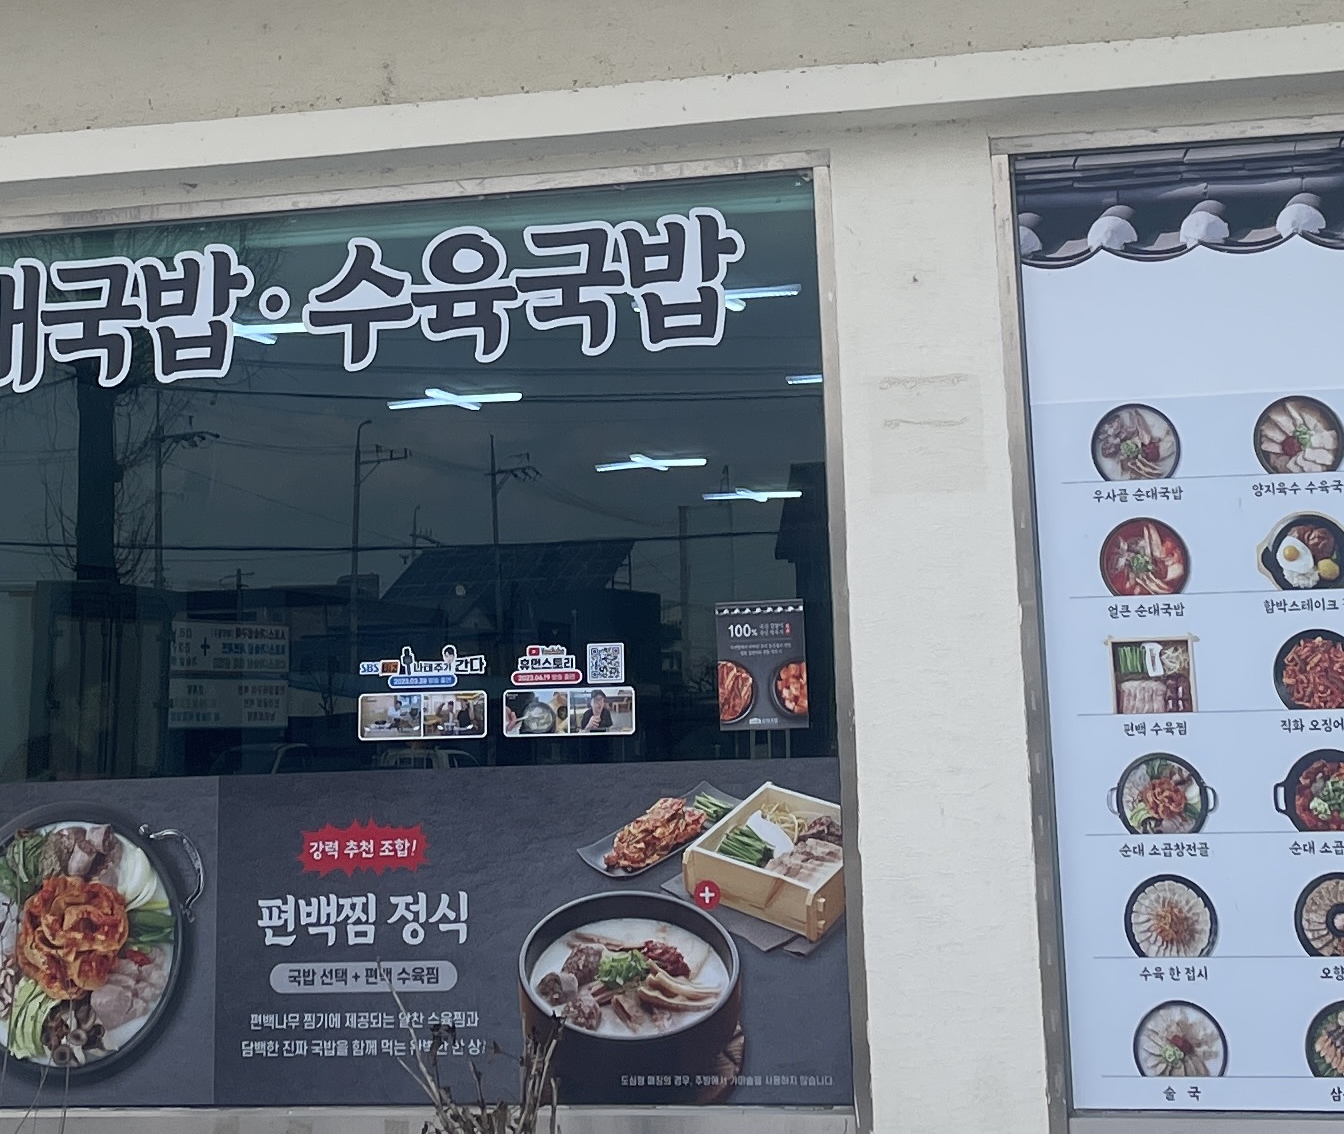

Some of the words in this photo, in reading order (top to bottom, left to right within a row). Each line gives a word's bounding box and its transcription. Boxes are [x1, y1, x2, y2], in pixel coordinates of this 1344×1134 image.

[1092, 488, 1130, 503] 우사골
[1132, 486, 1184, 501] 순대국밥
[1252, 481, 1302, 497] 양지육수
[1134, 602, 1185, 618] 순대국밥
[1263, 598, 1339, 614] 함박스테이크
[360, 663, 379, 673] SBS
[519, 657, 575, 671] 휴먼스토리
[1123, 722, 1147, 737] 편백
[1149, 721, 1188, 736] 수육찜
[1280, 718, 1305, 733] 직화
[308, 840, 340, 860] 강력
[343, 839, 375, 859] 추천
[379, 838, 417, 858] 조합!
[1119, 843, 1145, 858] 순대
[1148, 841, 1210, 857] 소곱창전골
[1288, 840, 1316, 855] 순대
[256, 892, 377, 947] 편백찜
[386, 890, 469, 946] 정식
[287, 968, 317, 987] 국밥
[319, 968, 348, 987] 선택
[364, 967, 393, 986] 편백
[396, 966, 440, 985] 수육찜
[1138, 966, 1165, 981] 수육
[1168, 966, 1182, 981] 한
[1184, 966, 1209, 981] 접시
[250, 1013, 302, 1030] 편백나무
[302, 1013, 341, 1030] 찜기에
[344, 1012, 395, 1029] 제공되는
[241, 1040, 279, 1058] 담백한
[282, 1040, 308, 1057] 진짜
[310, 1039, 349, 1057] 국밥을
[351, 1039, 378, 1056] 함께
[380, 1039, 406, 1056] 먹는
